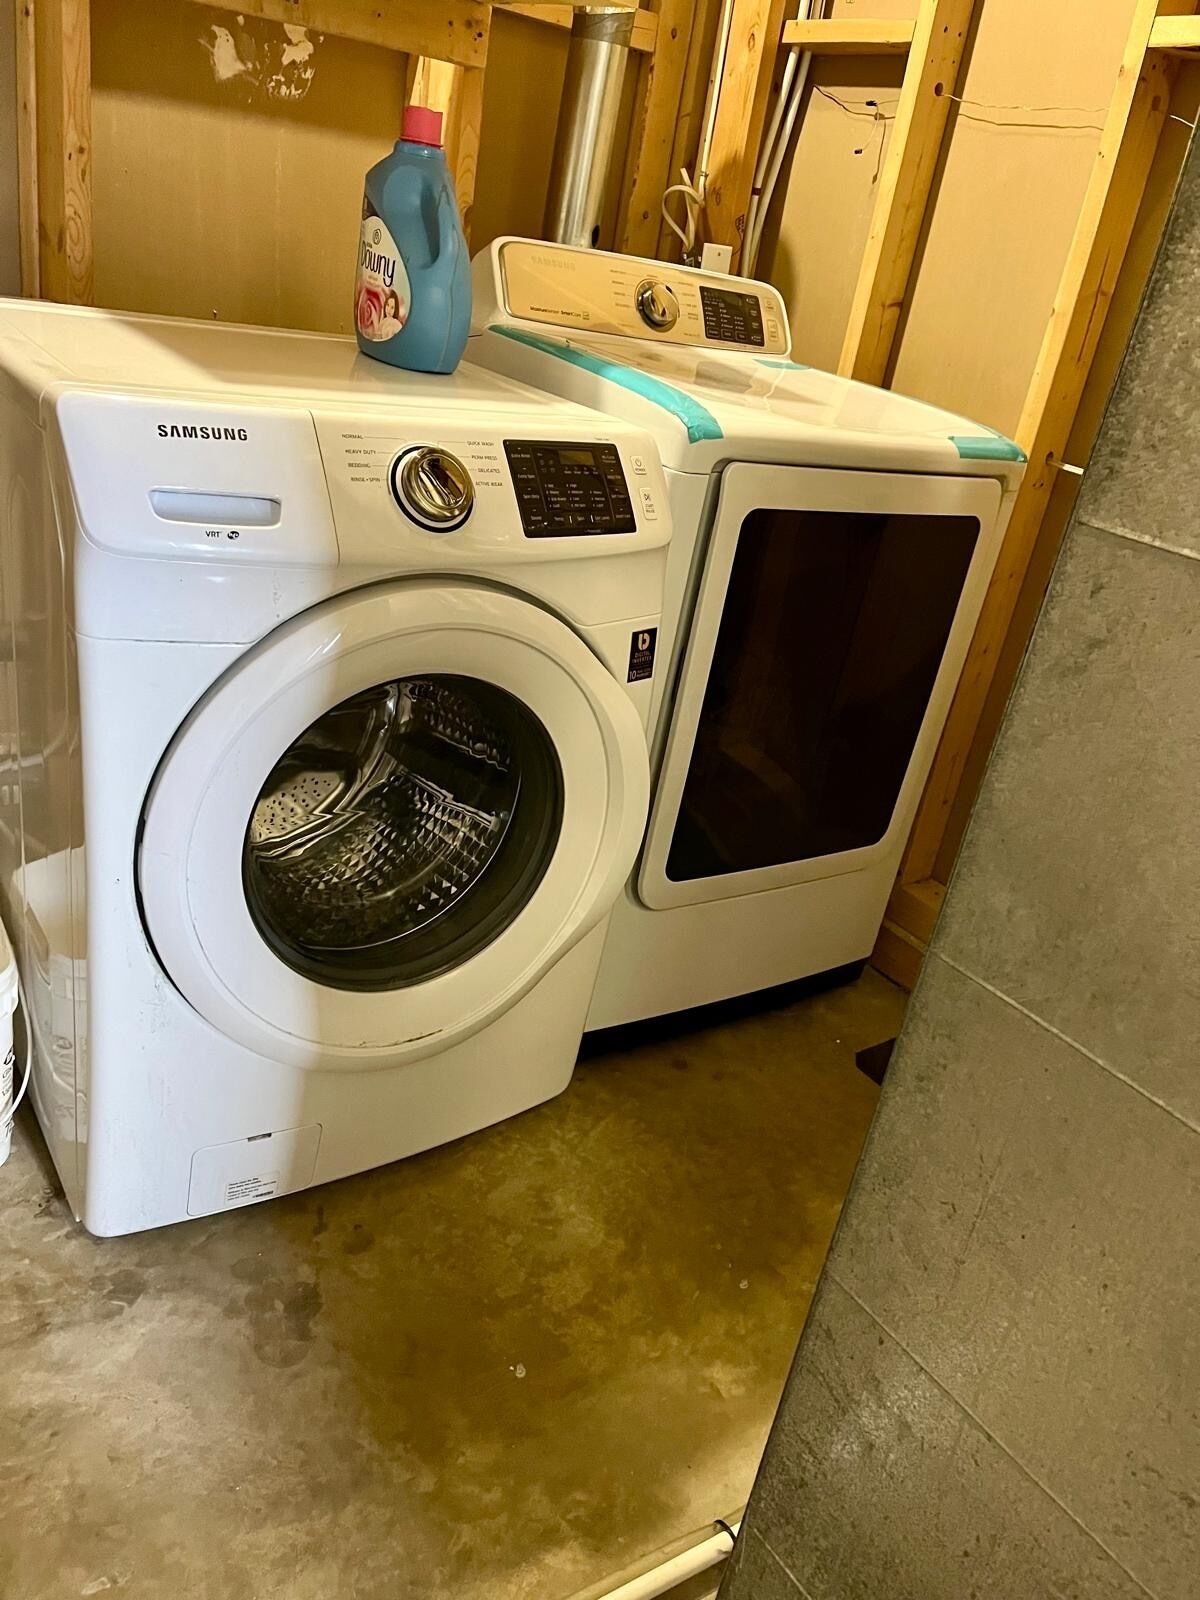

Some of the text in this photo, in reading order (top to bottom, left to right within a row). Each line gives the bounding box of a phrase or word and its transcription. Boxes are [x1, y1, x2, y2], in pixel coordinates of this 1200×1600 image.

[361, 239, 396, 288] Downy
[157, 424, 248, 441] SAMSUNG
[205, 530, 220, 538] VRT
[629, 670, 636, 681] 10
